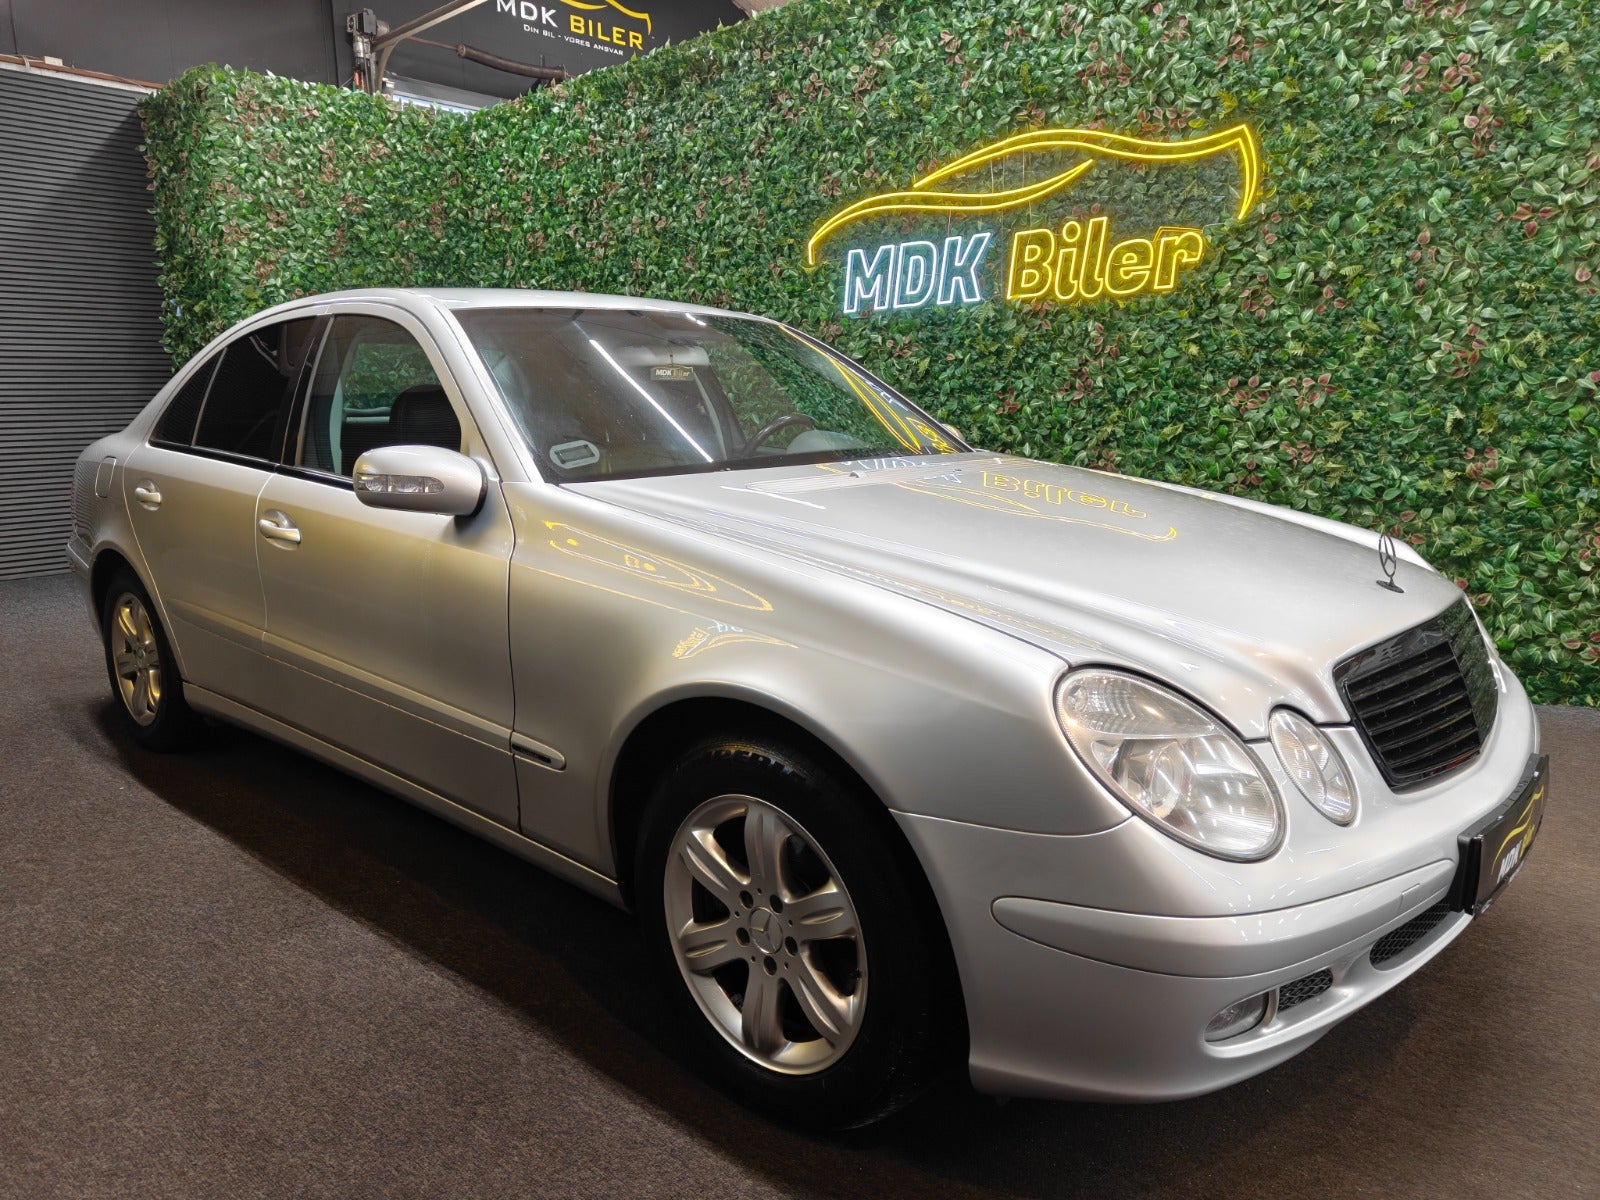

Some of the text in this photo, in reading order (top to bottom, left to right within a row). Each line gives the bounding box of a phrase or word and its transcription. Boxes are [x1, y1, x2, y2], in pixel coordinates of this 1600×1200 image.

[496, 0, 644, 50] MDK BILER
[564, 35, 591, 48] VORES
[593, 43, 624, 56] ANSVAR
[842, 215, 1205, 314] MDK Biler
